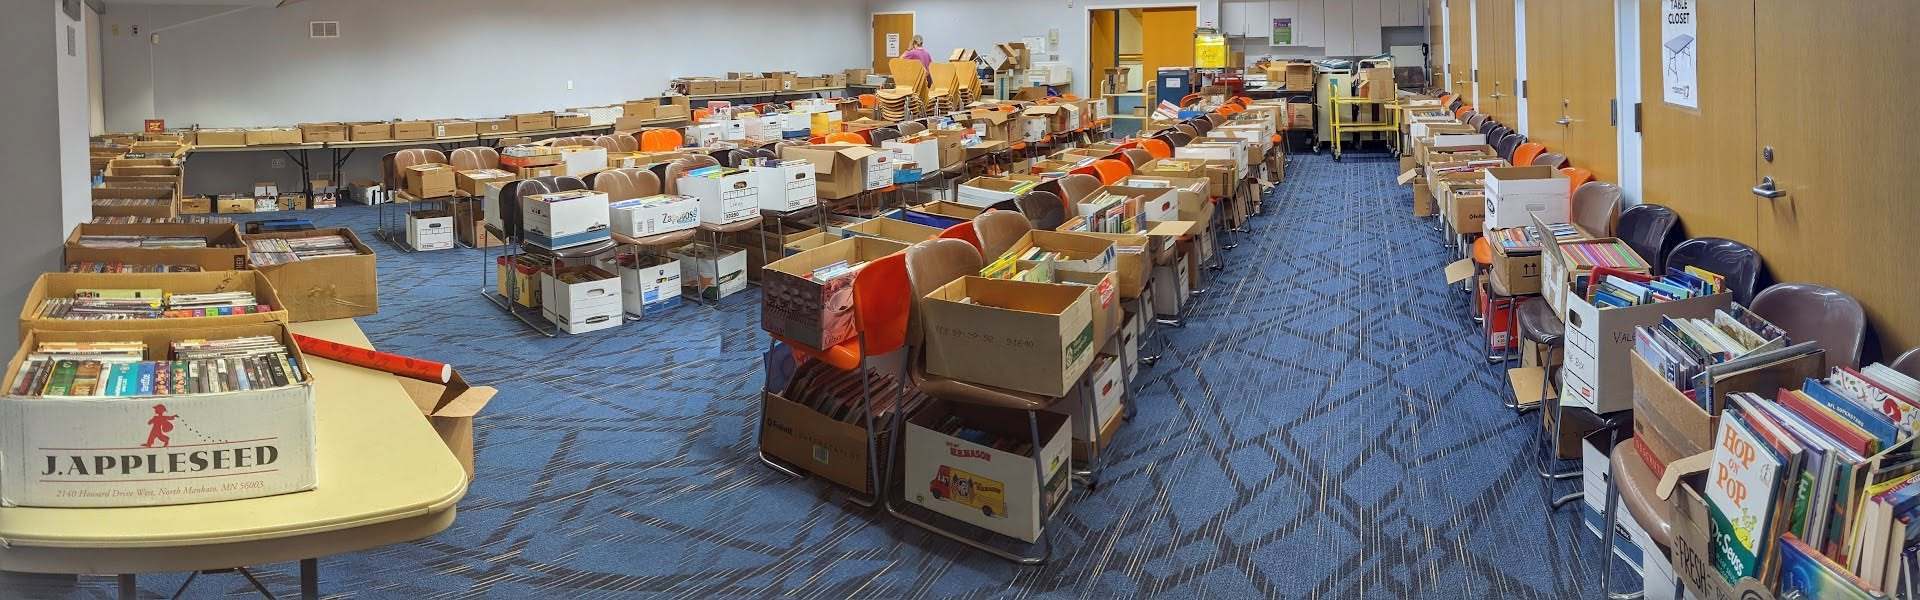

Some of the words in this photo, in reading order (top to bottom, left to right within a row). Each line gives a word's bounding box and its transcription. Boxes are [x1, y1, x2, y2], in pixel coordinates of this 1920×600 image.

[1668, 12, 1690, 24] CLOSET
[1670, 0, 1688, 9] TABLE
[1723, 424, 1756, 470] HOP
[112, 488, 134, 497] Drive
[159, 487, 181, 496] North
[221, 481, 238, 491] MN
[240, 480, 265, 490] 56003
[1716, 462, 1747, 509] POP
[1721, 533, 1744, 577] Seuss
